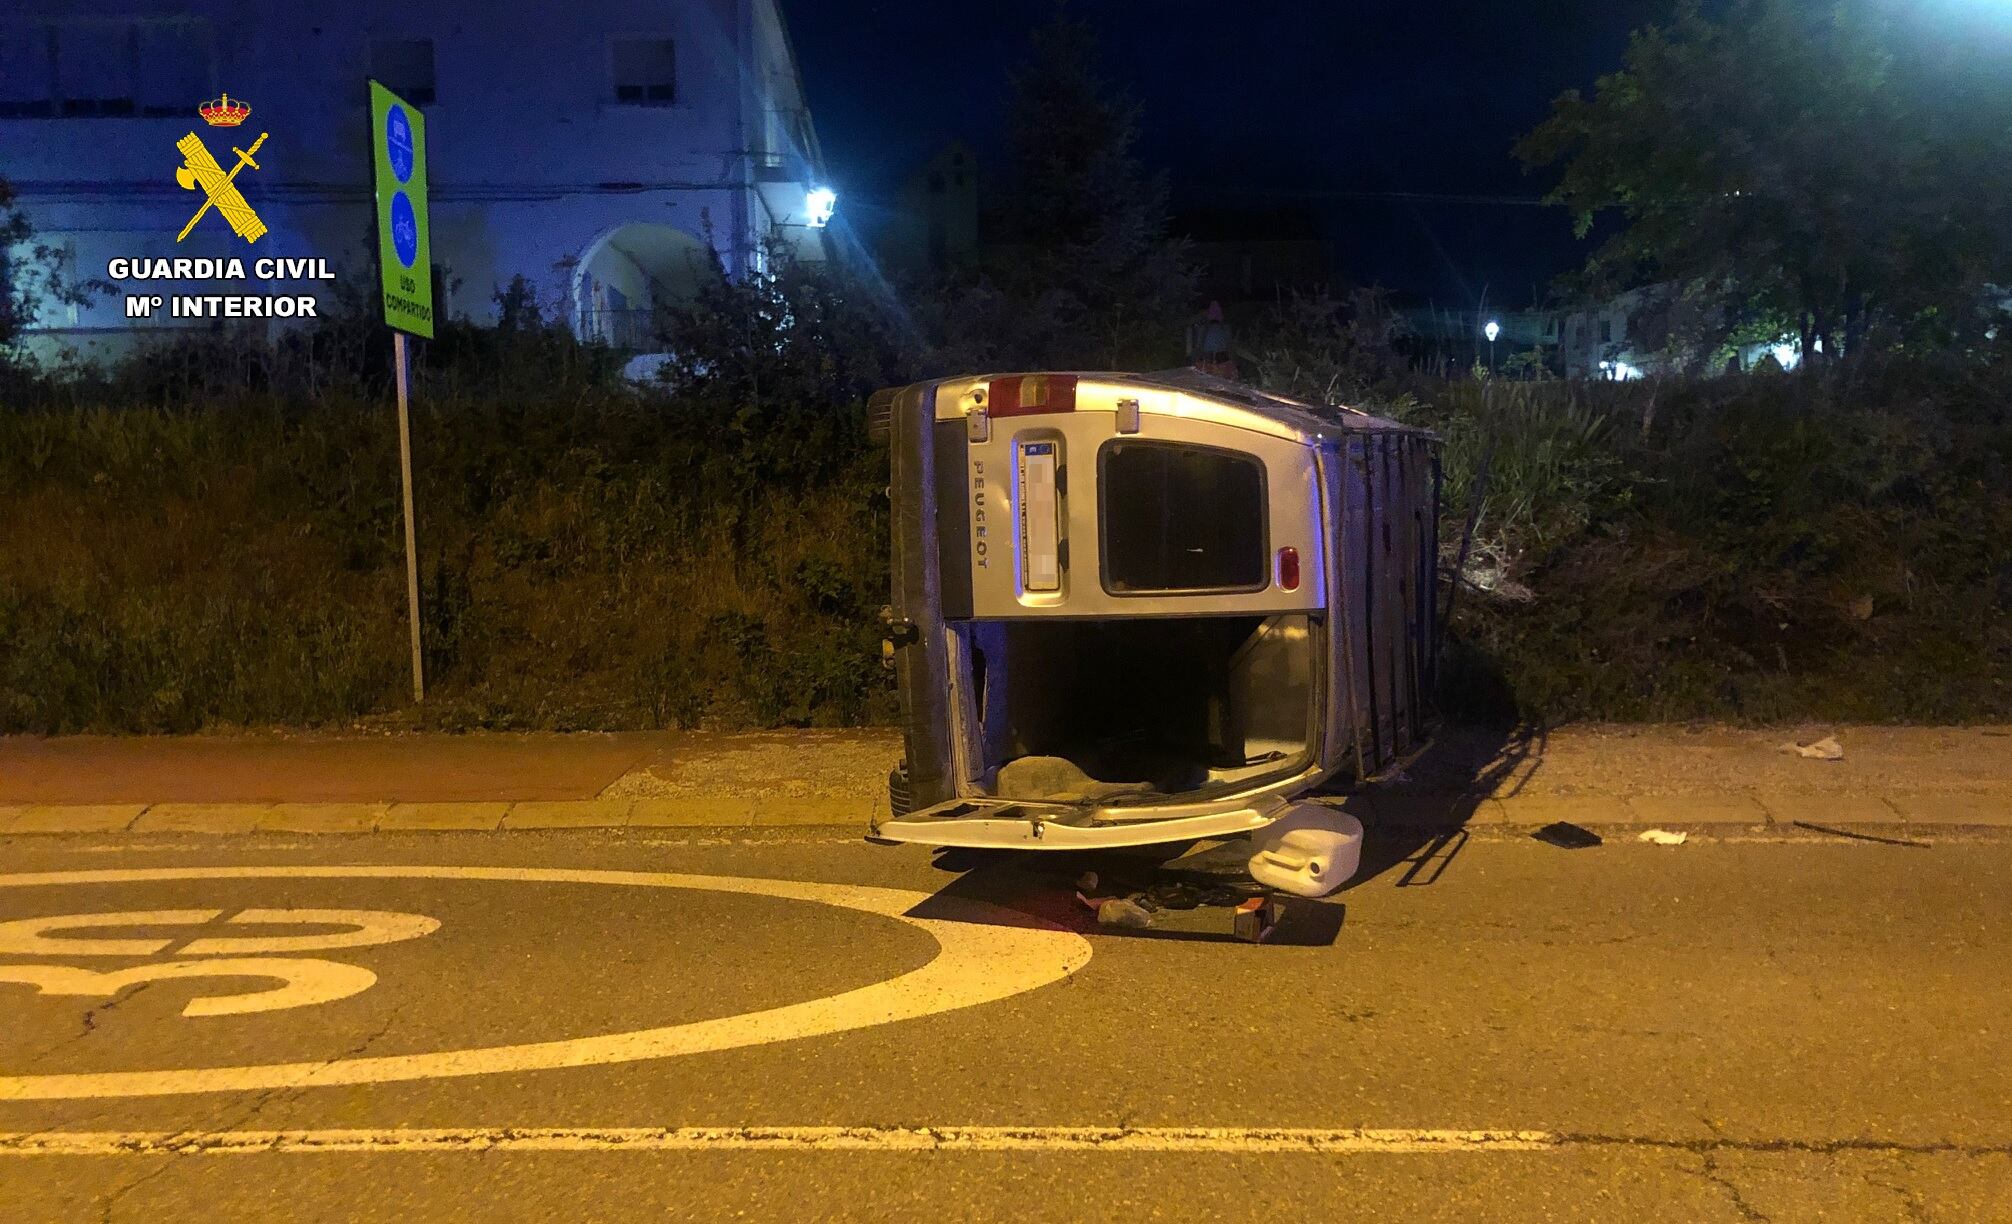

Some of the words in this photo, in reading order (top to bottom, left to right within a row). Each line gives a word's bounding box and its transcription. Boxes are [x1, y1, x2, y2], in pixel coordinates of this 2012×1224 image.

[400, 274, 416, 294] USO
[386, 293, 431, 321] COMPARTIDO
[974, 461, 988, 569] PEUGEOT
